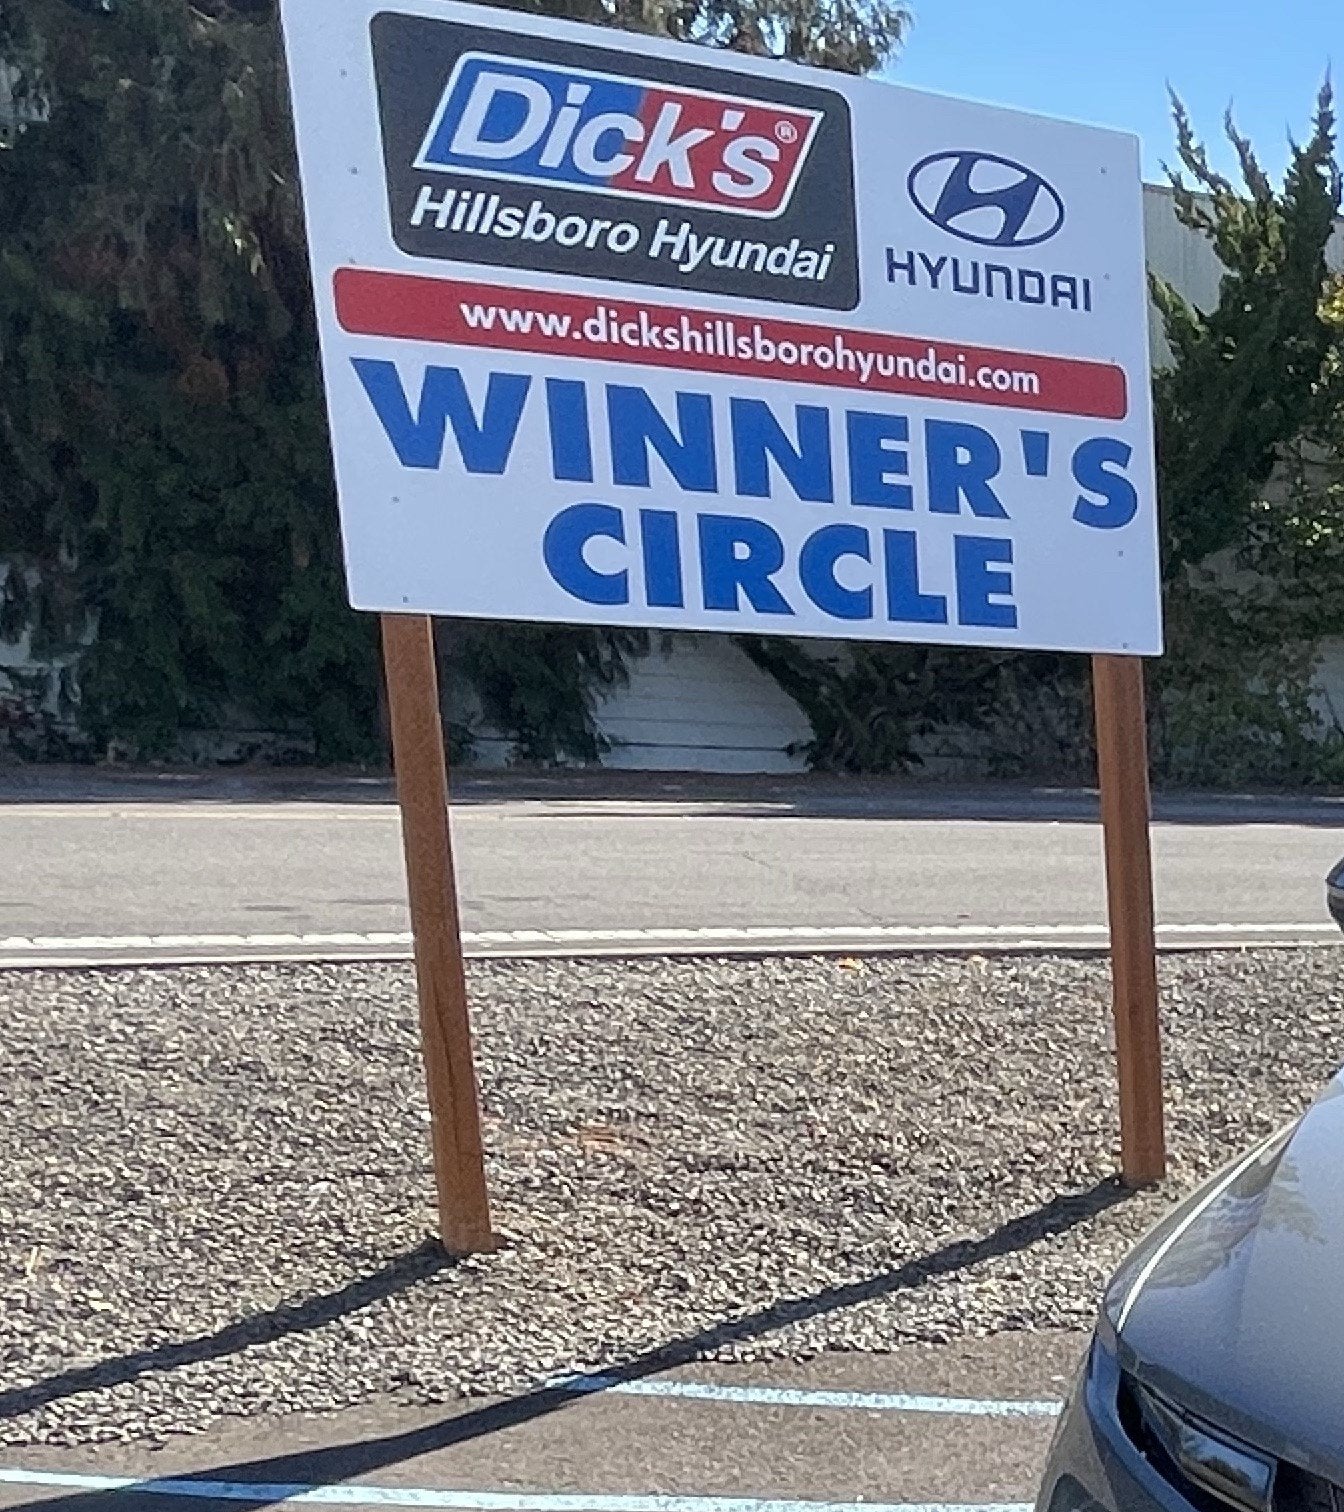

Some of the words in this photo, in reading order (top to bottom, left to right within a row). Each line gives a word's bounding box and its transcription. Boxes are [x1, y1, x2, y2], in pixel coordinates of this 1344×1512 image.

[449, 71, 785, 198] Dick's
[409, 185, 641, 254] Hillsboro
[649, 219, 834, 283] Hyundai
[885, 247, 1093, 312] HYUNDAI
[459, 302, 1040, 395] www.dickshillsborohyundai.com
[349, 356, 1139, 529] WINNER'S
[542, 502, 1019, 630] CIRCLE
